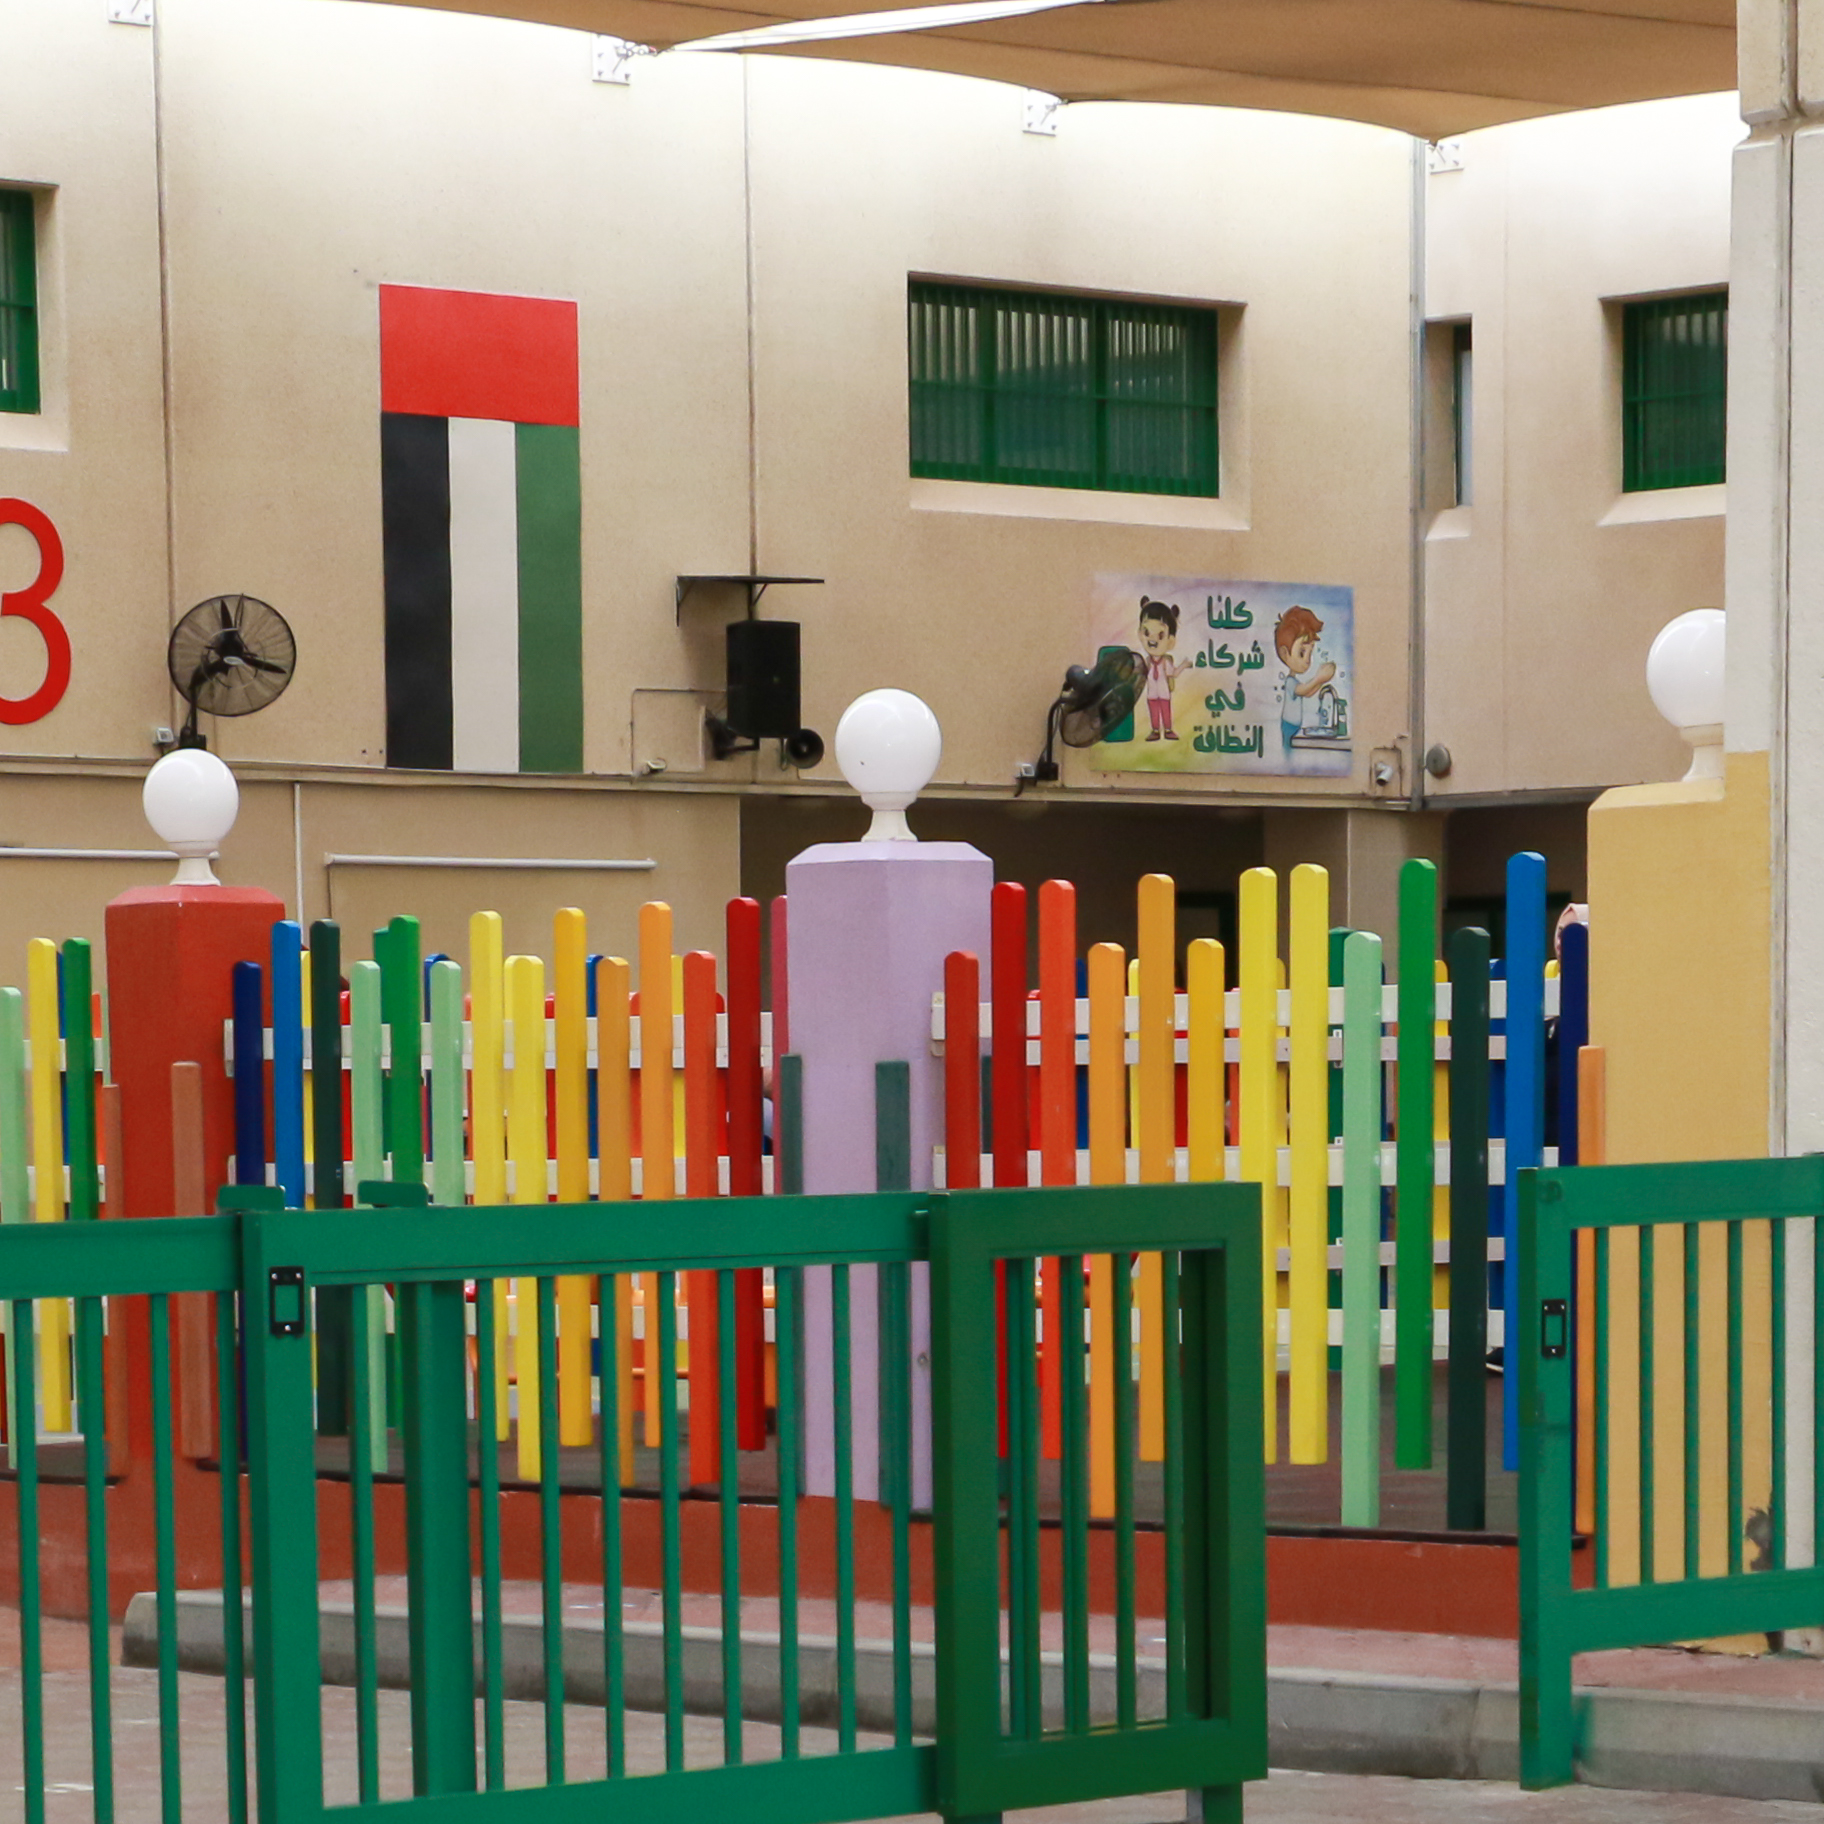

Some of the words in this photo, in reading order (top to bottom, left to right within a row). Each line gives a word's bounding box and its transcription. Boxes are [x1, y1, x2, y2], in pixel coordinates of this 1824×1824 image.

[1207, 594, 1254, 630] كلنا
[1194, 638, 1265, 676] شركاء
[1204, 681, 1246, 719] في
[1192, 724, 1264, 759] النظافة
